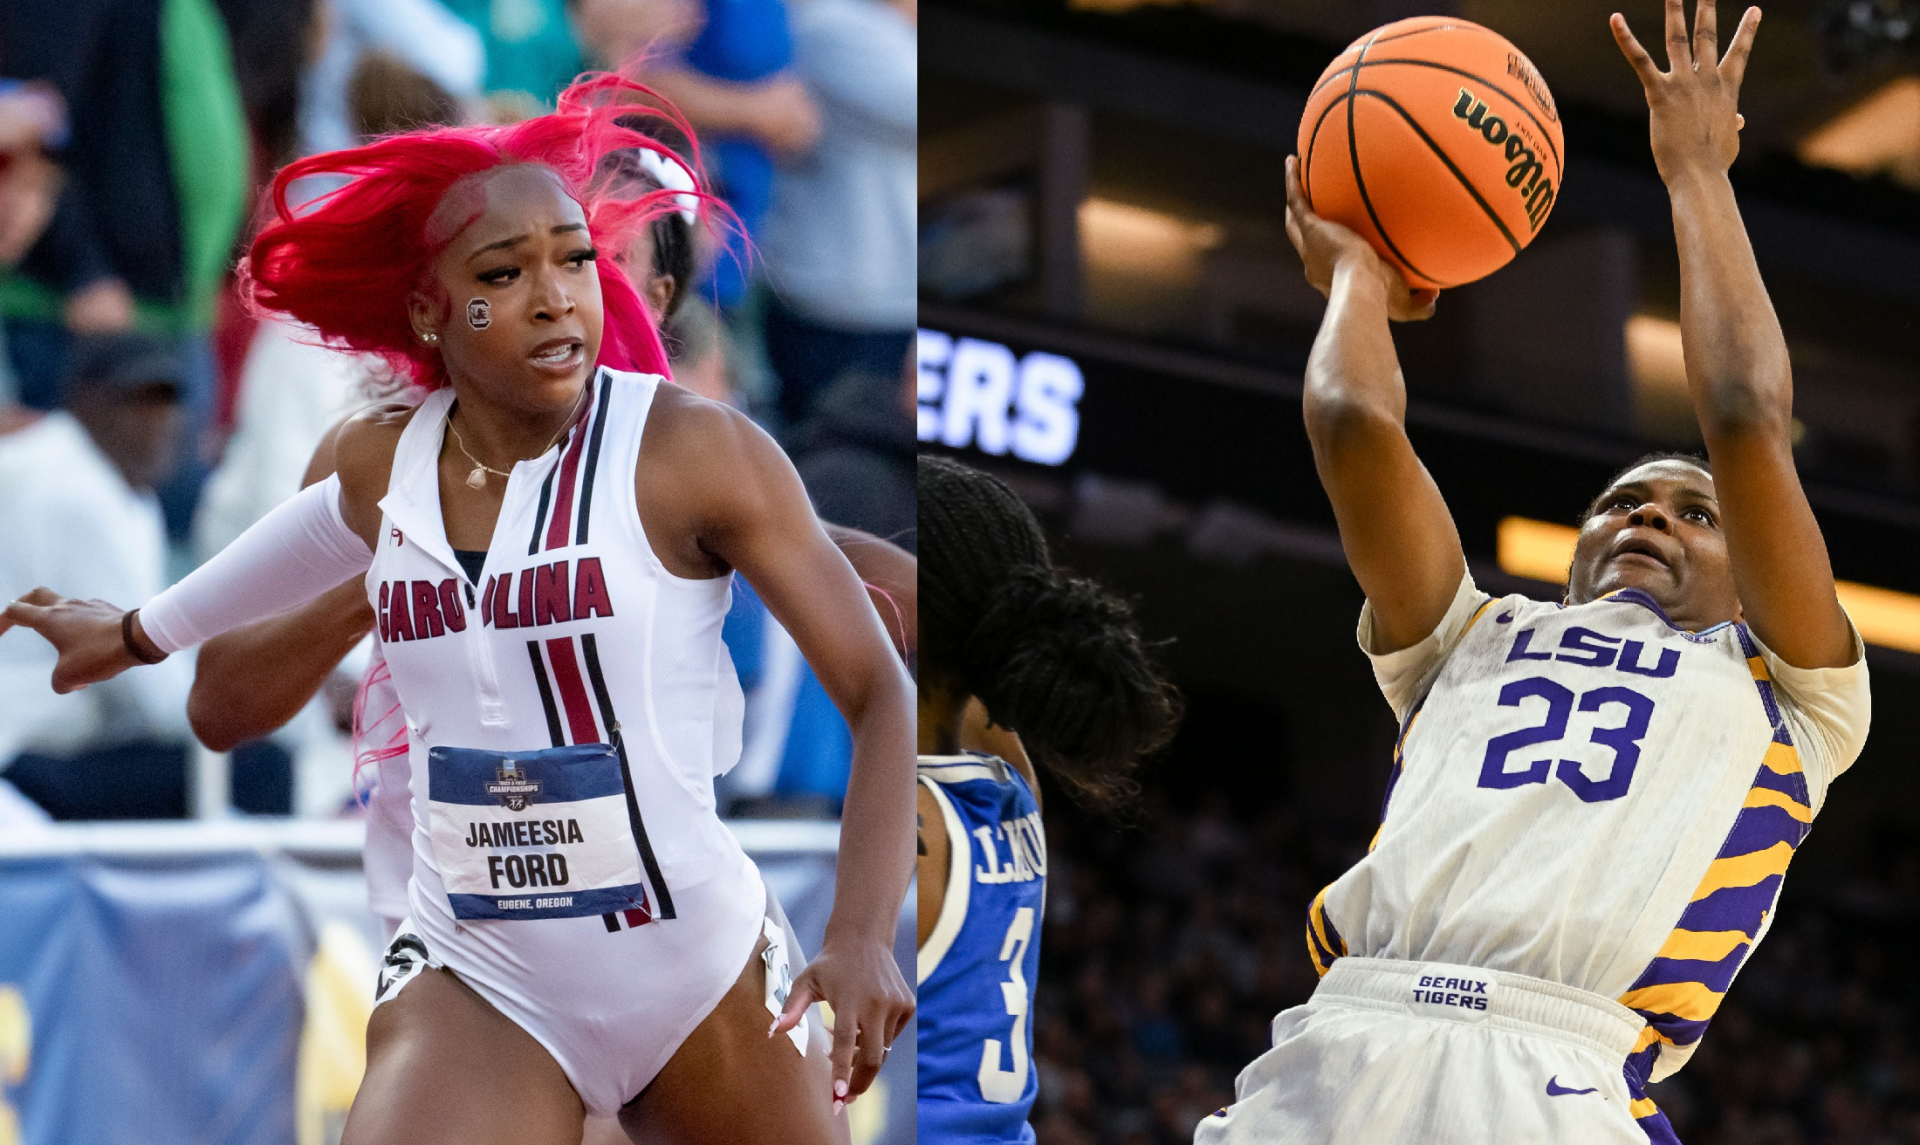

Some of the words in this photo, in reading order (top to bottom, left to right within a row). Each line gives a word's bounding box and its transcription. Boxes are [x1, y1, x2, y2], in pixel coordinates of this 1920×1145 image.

[1453, 87, 1554, 233] Wilson
[379, 556, 615, 643] CAROLINA
[1505, 626, 1682, 678] LSU
[1477, 676, 1656, 803] 23
[489, 784, 539, 793] CHAMPIONSHIPS
[465, 818, 584, 848] JAMEESIA
[487, 853, 569, 889] FORD
[497, 899, 534, 910] EUGENE,
[536, 897, 573, 909] OREGON
[1413, 989, 1488, 1011] TIGERS
[1419, 975, 1488, 995] GEAUX
[977, 907, 1034, 1104] 3
